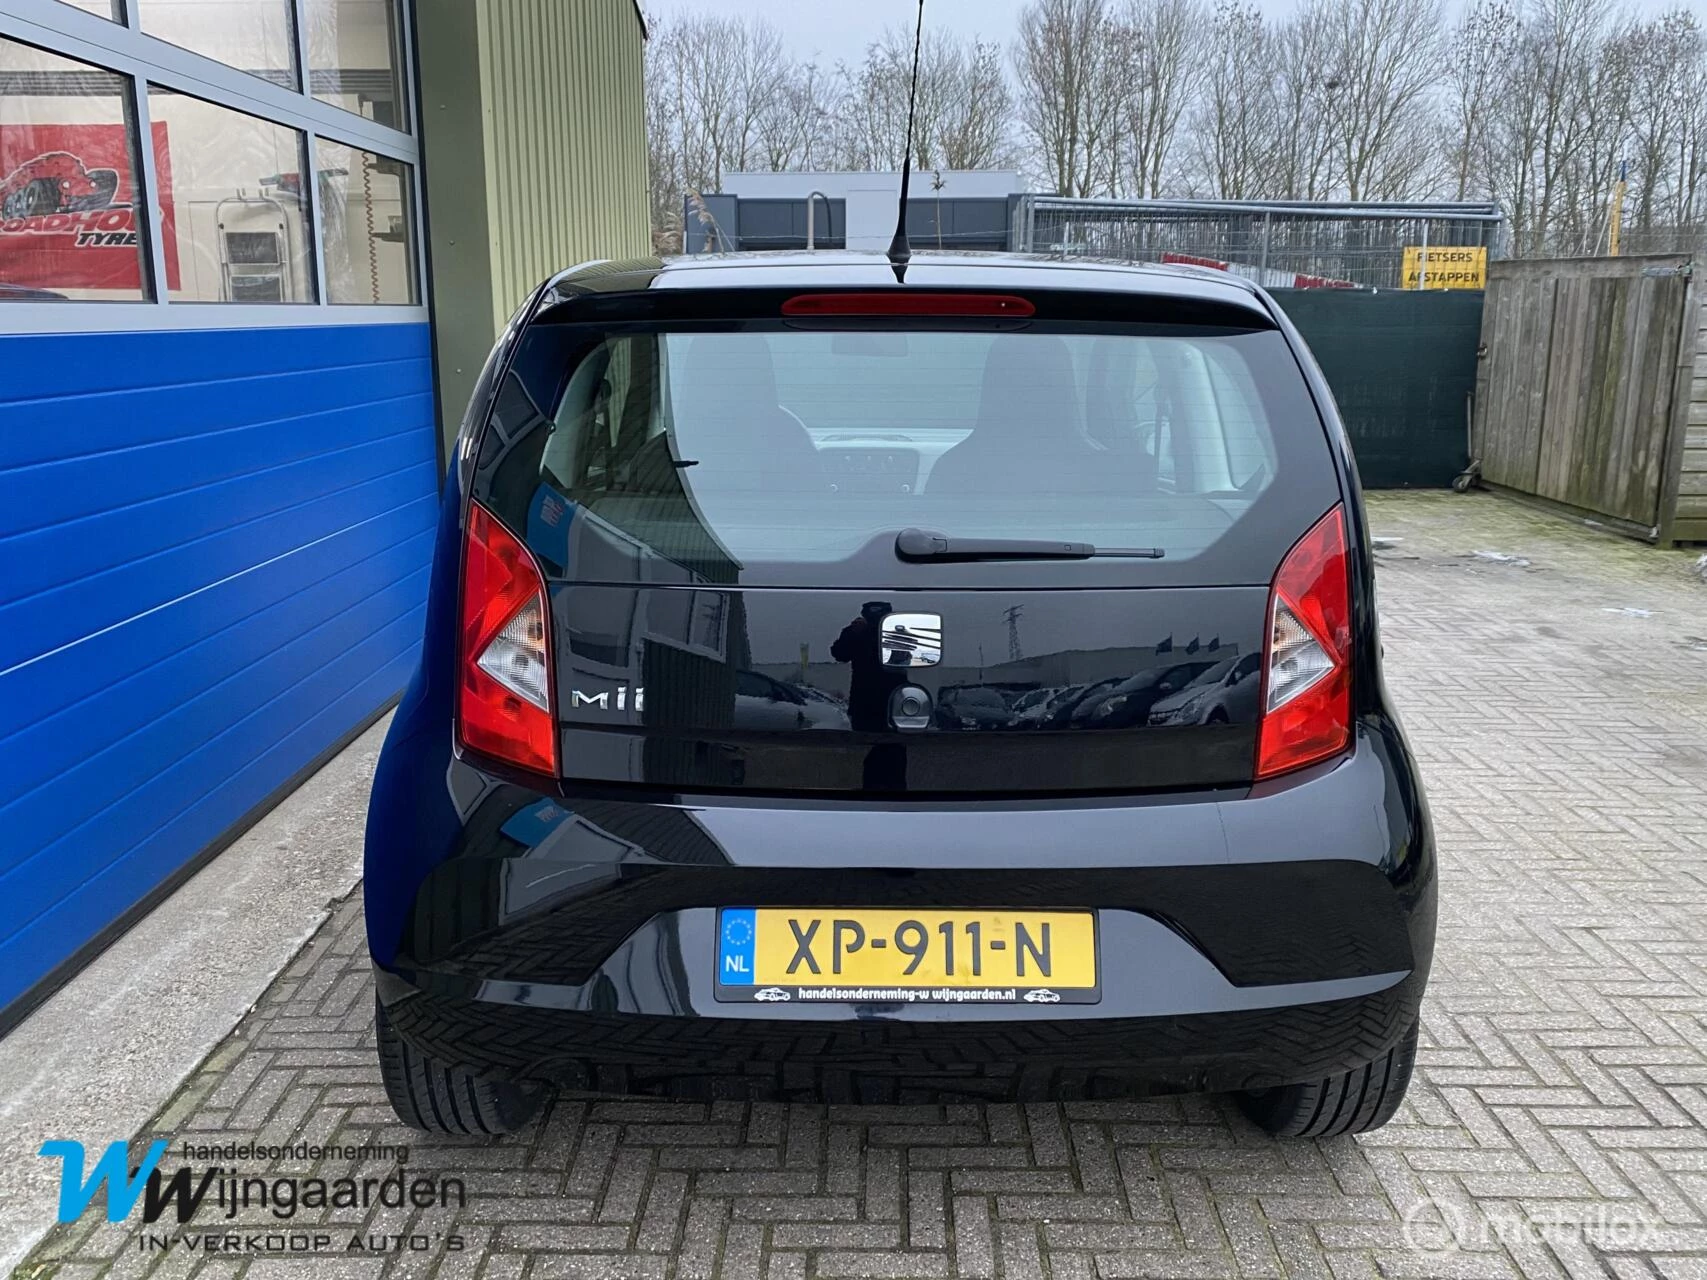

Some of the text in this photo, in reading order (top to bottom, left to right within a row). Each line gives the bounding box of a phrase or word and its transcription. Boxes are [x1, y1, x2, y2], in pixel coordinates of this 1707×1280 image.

[0, 208, 138, 233] OADHO
[571, 686, 644, 712] Mii
[786, 919, 1051, 977] XP-911-N
[725, 955, 750, 973] NL
